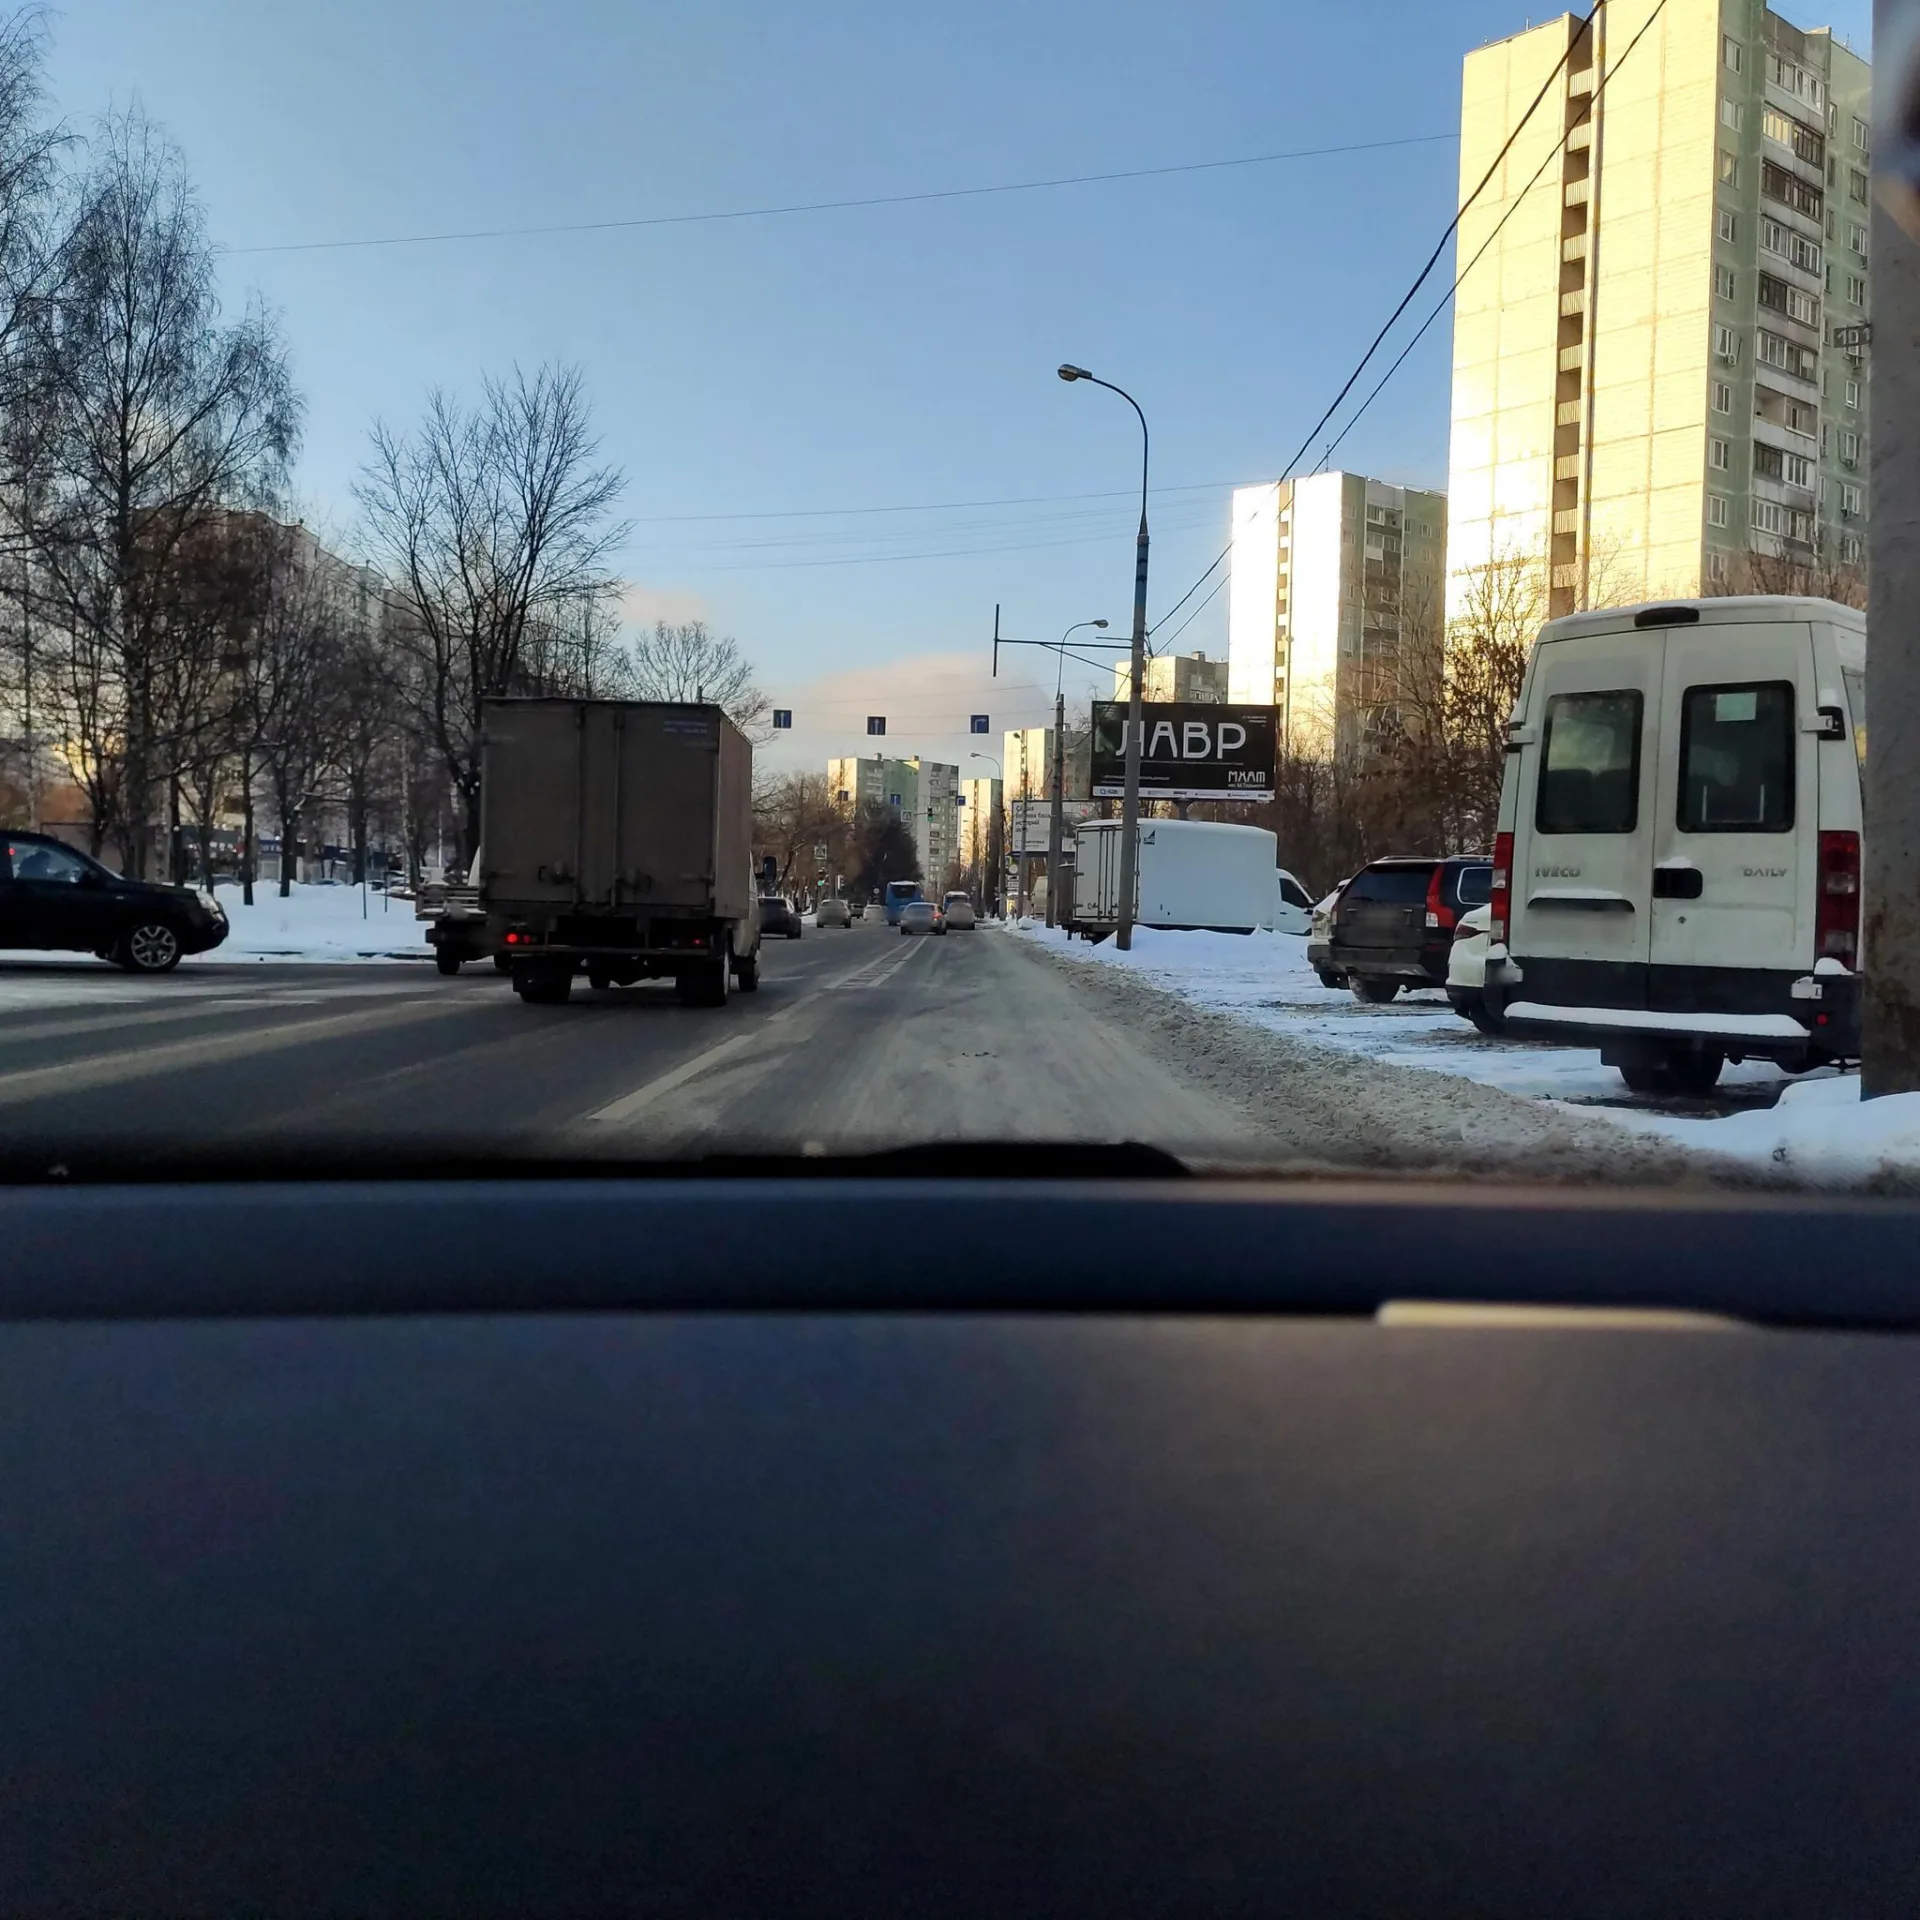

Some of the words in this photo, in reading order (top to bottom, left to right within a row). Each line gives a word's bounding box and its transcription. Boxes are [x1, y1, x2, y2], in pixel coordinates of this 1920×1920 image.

[1115, 720, 1247, 760] ЛАВР
[1535, 867, 1581, 878] IVECO
[1743, 867, 1788, 877] DAILY
